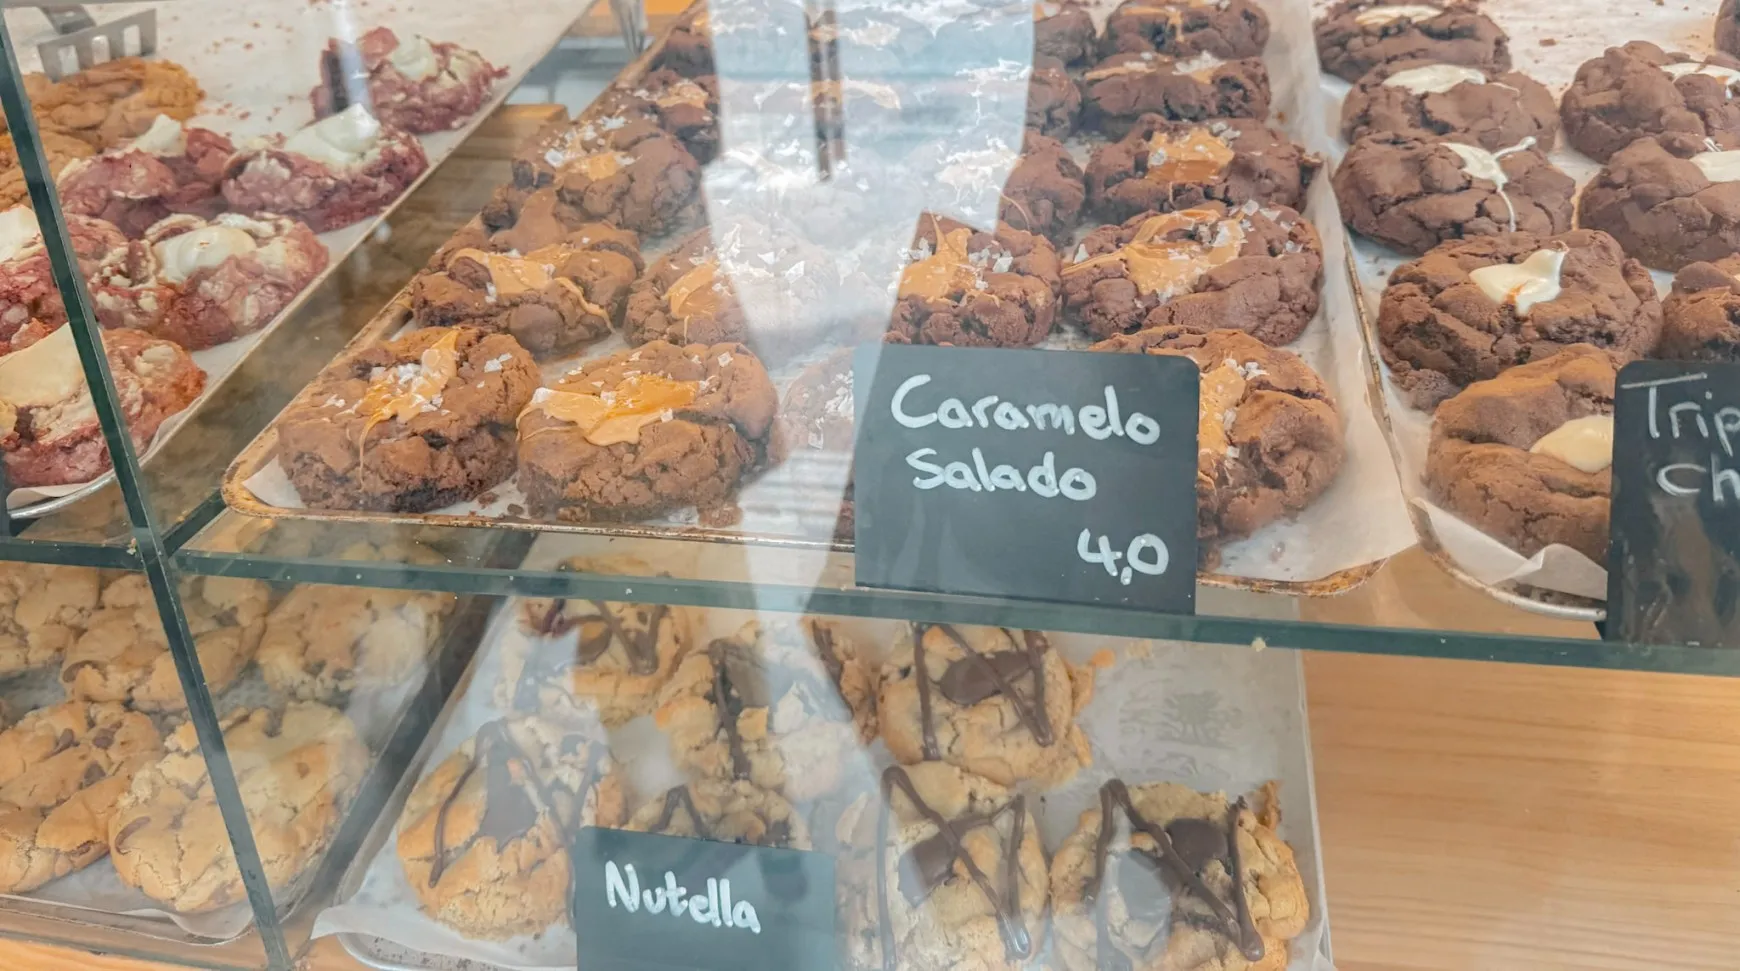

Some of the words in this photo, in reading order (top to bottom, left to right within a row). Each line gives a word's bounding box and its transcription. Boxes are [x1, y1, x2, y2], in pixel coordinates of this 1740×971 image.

[890, 373, 1160, 445] Caramelo
[905, 447, 1097, 500] Salado
[1077, 528, 1170, 585] 4,0
[605, 860, 761, 933] Nutella
